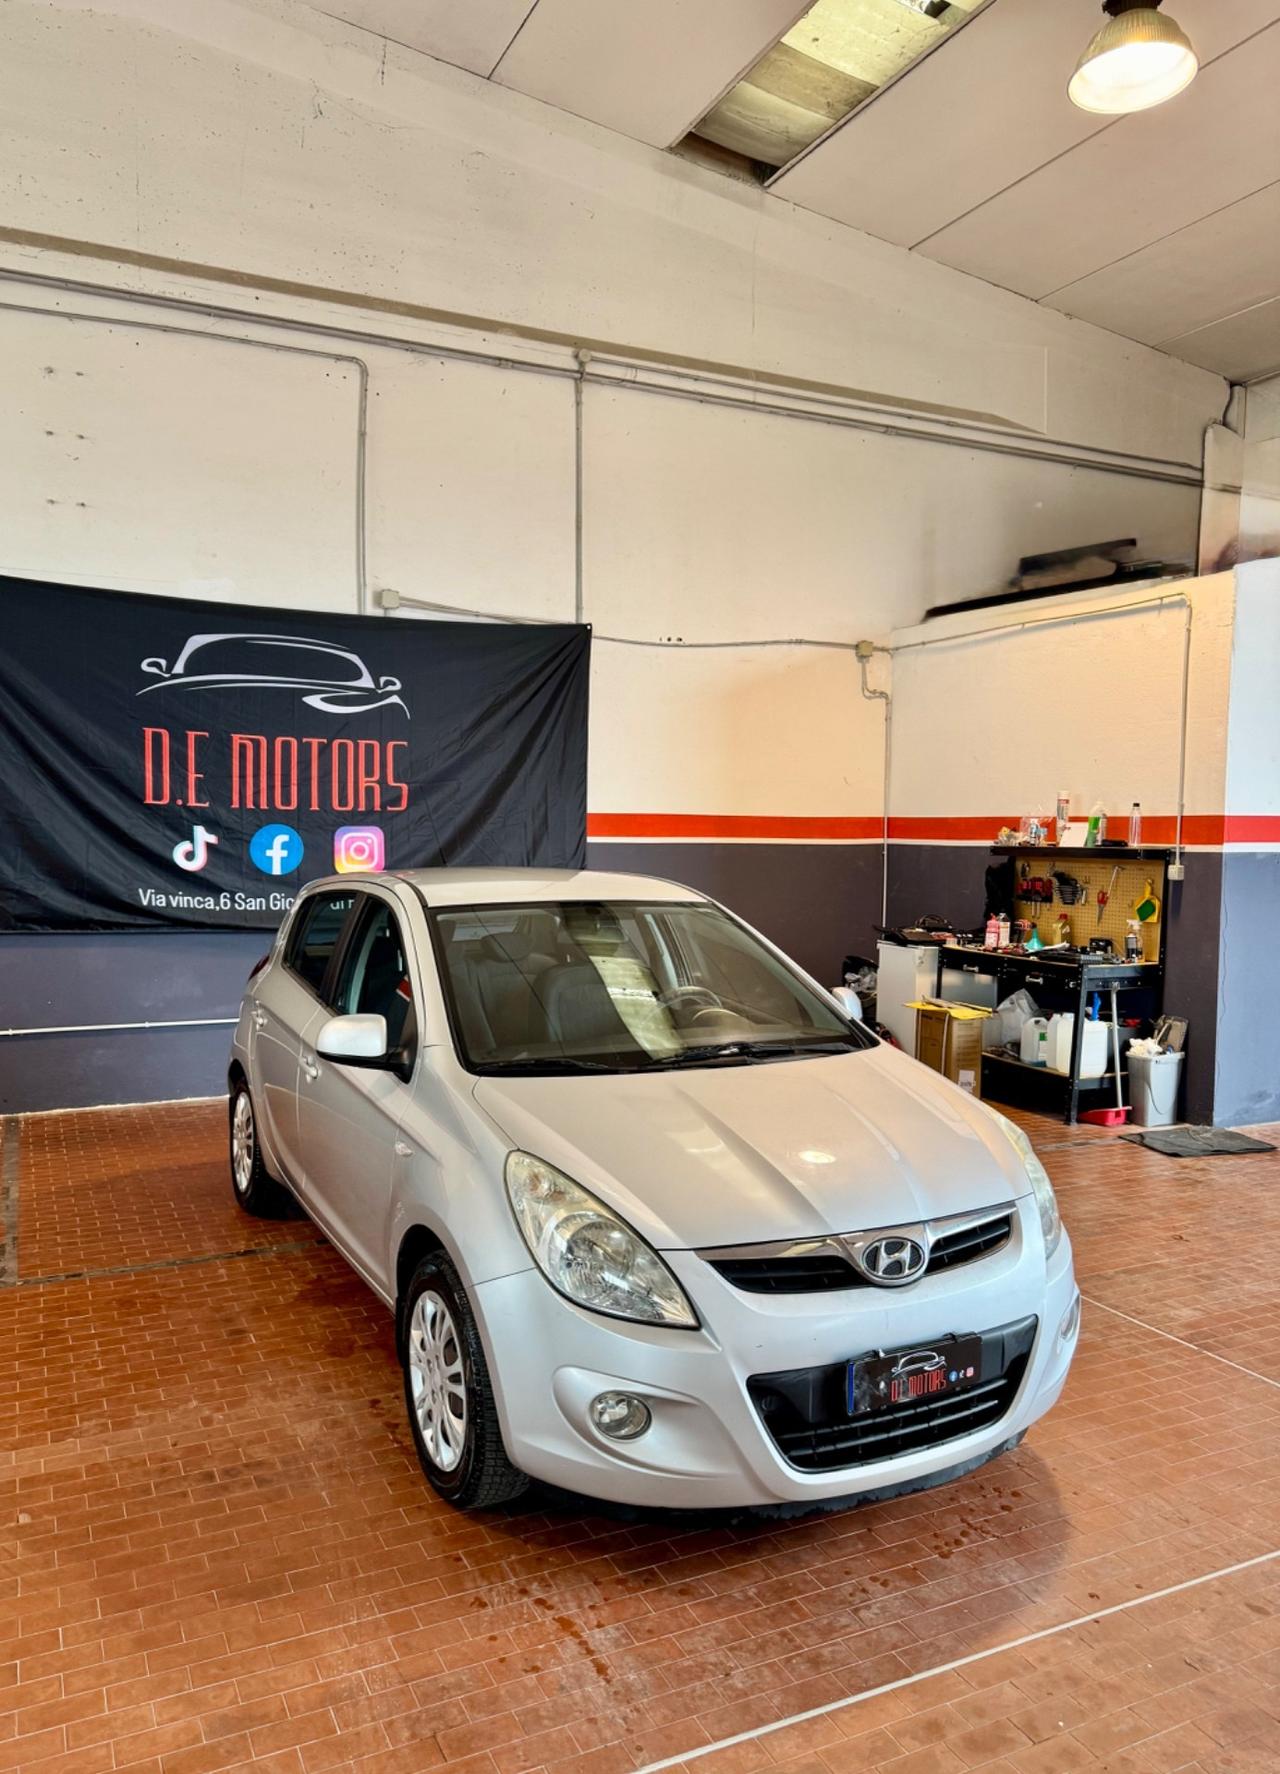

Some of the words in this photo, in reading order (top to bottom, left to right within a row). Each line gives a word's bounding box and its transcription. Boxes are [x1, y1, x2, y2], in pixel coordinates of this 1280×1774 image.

[142, 727, 210, 808] D.E
[230, 733, 409, 812] MOTORS
[138, 888, 167, 907] Via
[234, 892, 266, 910] San
